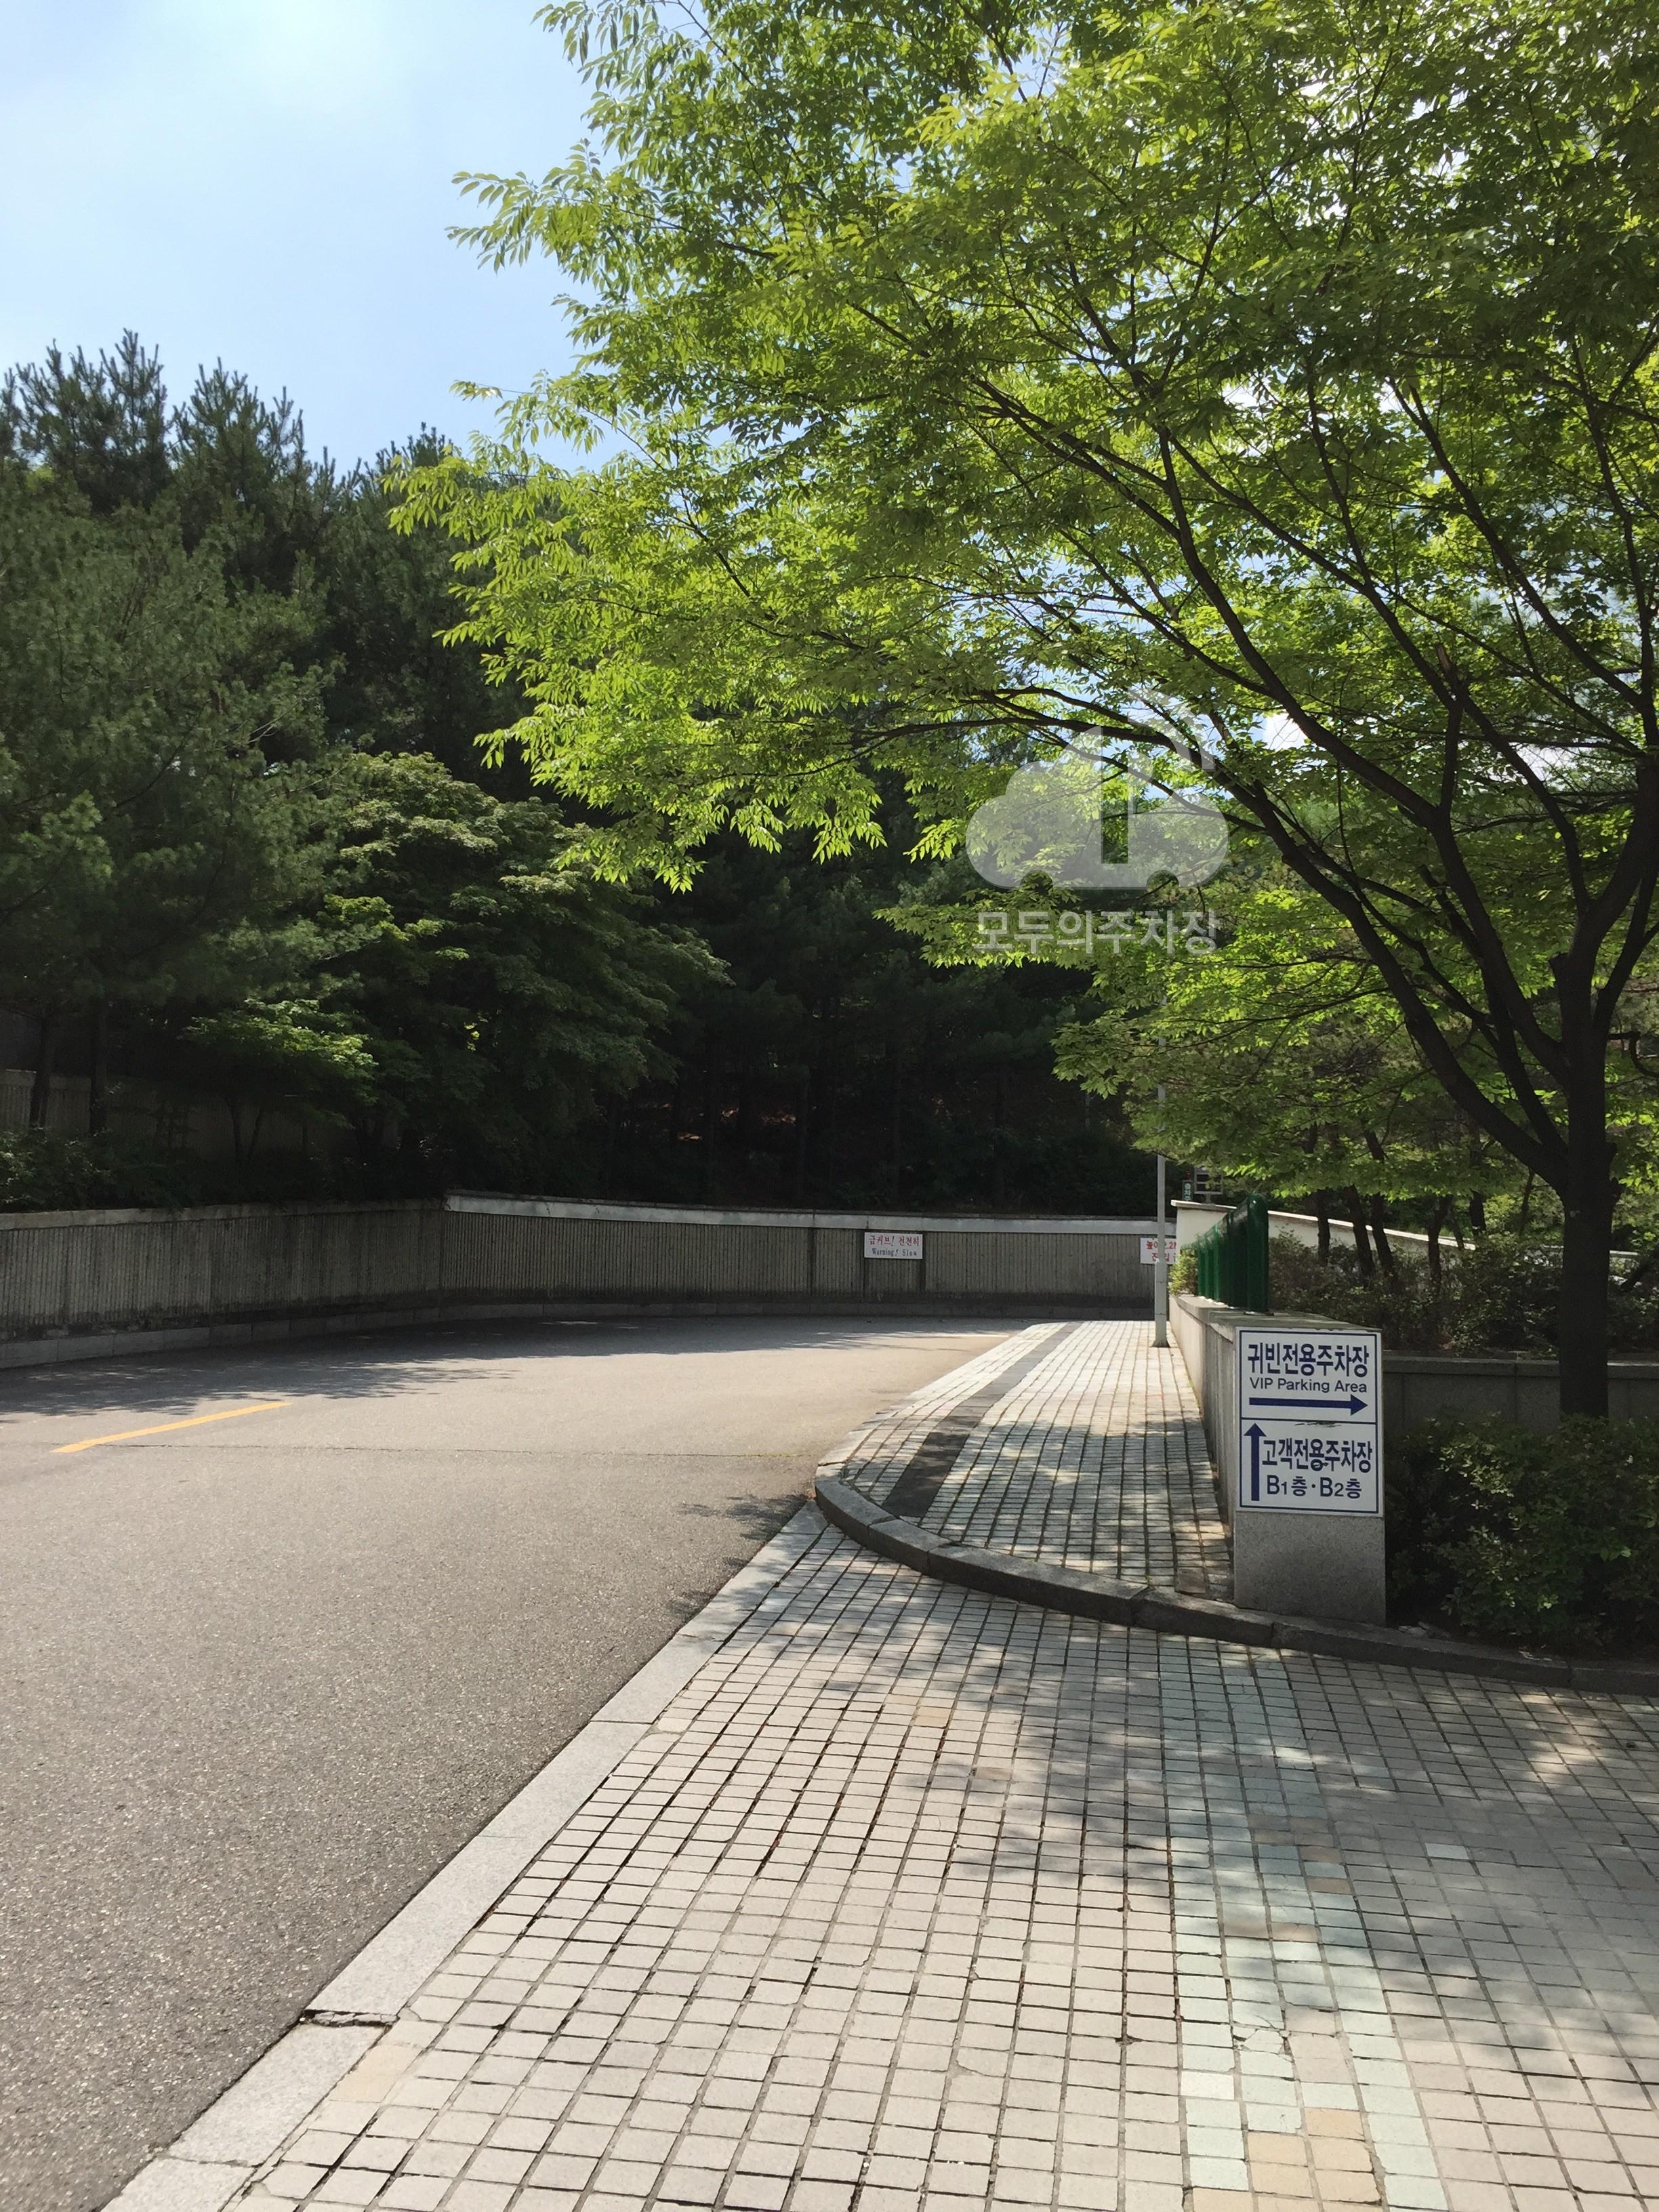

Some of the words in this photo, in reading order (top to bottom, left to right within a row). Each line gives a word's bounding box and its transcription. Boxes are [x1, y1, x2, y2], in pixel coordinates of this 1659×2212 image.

[899, 1235, 920, 1247] 천천히
[902, 1248, 917, 1256] Slow
[1248, 1342, 1370, 1378] 귀빈전용주차장
[1249, 1376, 1273, 1389] VIP
[1277, 1378, 1330, 1393] Parking
[1334, 1380, 1368, 1393] Area
[1262, 1437, 1373, 1473] 고객전용주차장
